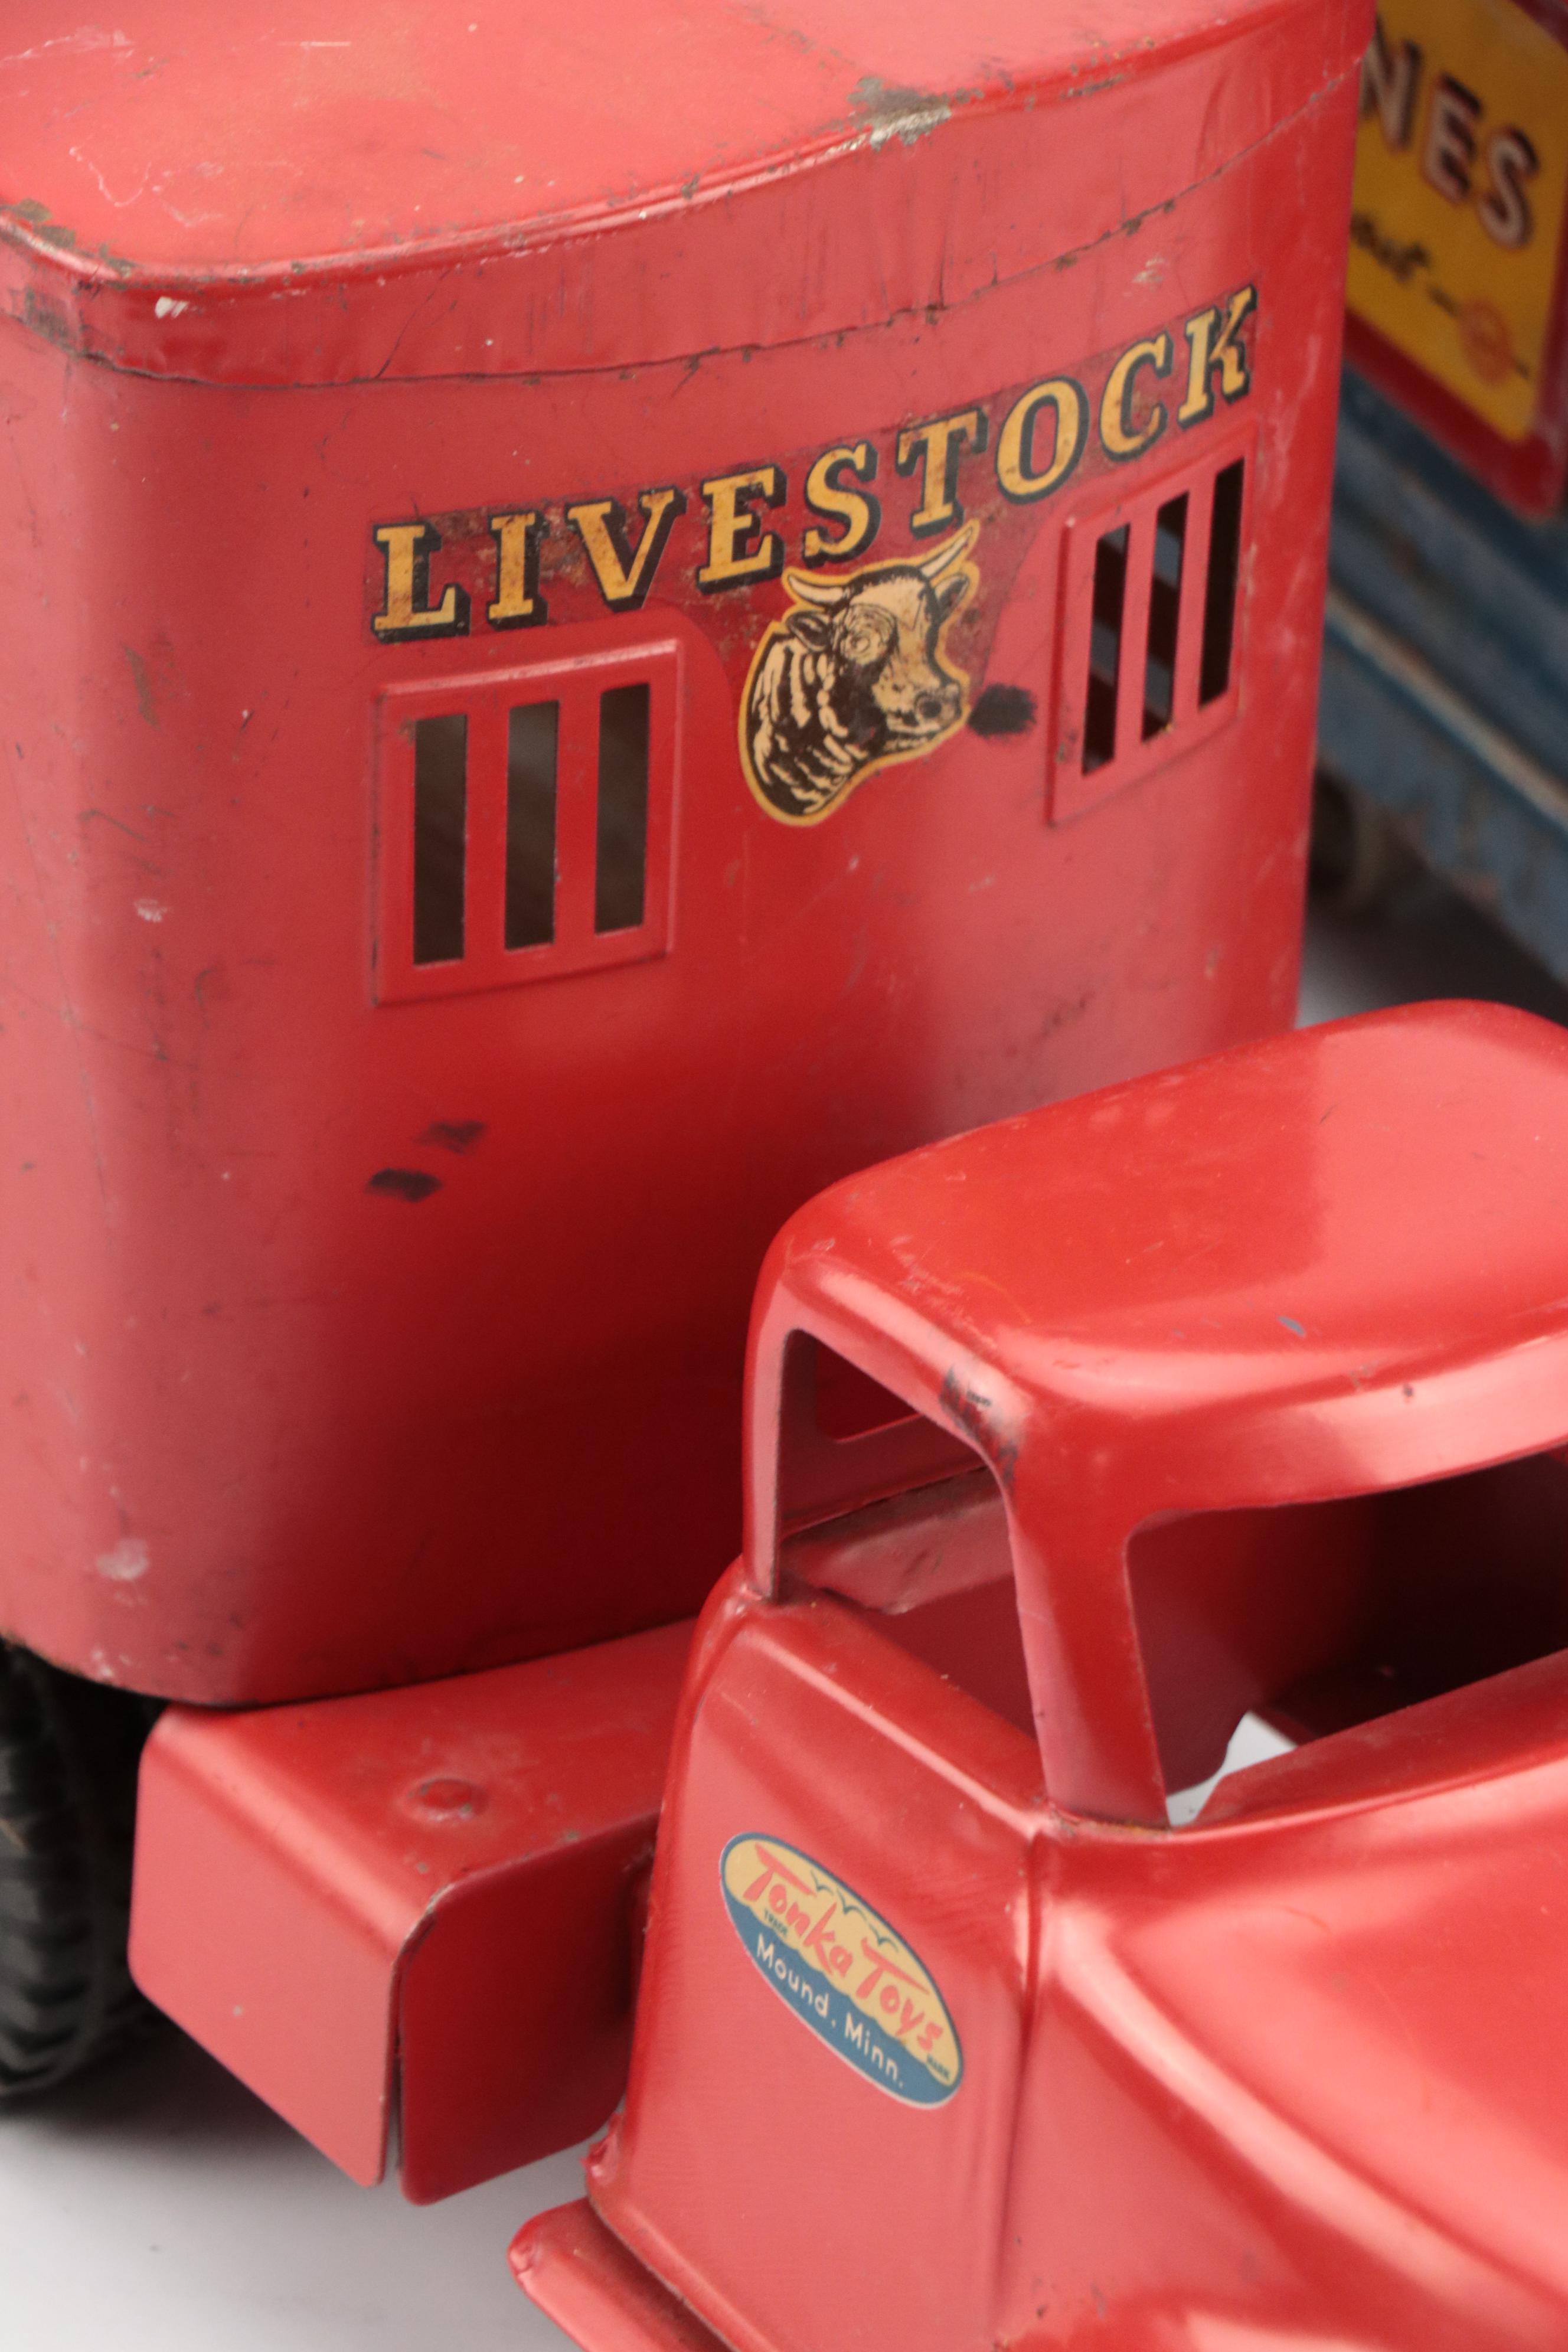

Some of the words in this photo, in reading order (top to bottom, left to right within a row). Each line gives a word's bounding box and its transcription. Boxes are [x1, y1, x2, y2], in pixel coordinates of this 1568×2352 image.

[371, 285, 1257, 643] LIVESTOCK
[743, 1841, 854, 1979] Tonka
[855, 1936, 945, 2053] Toys
[844, 2012, 904, 2088] Minn.
